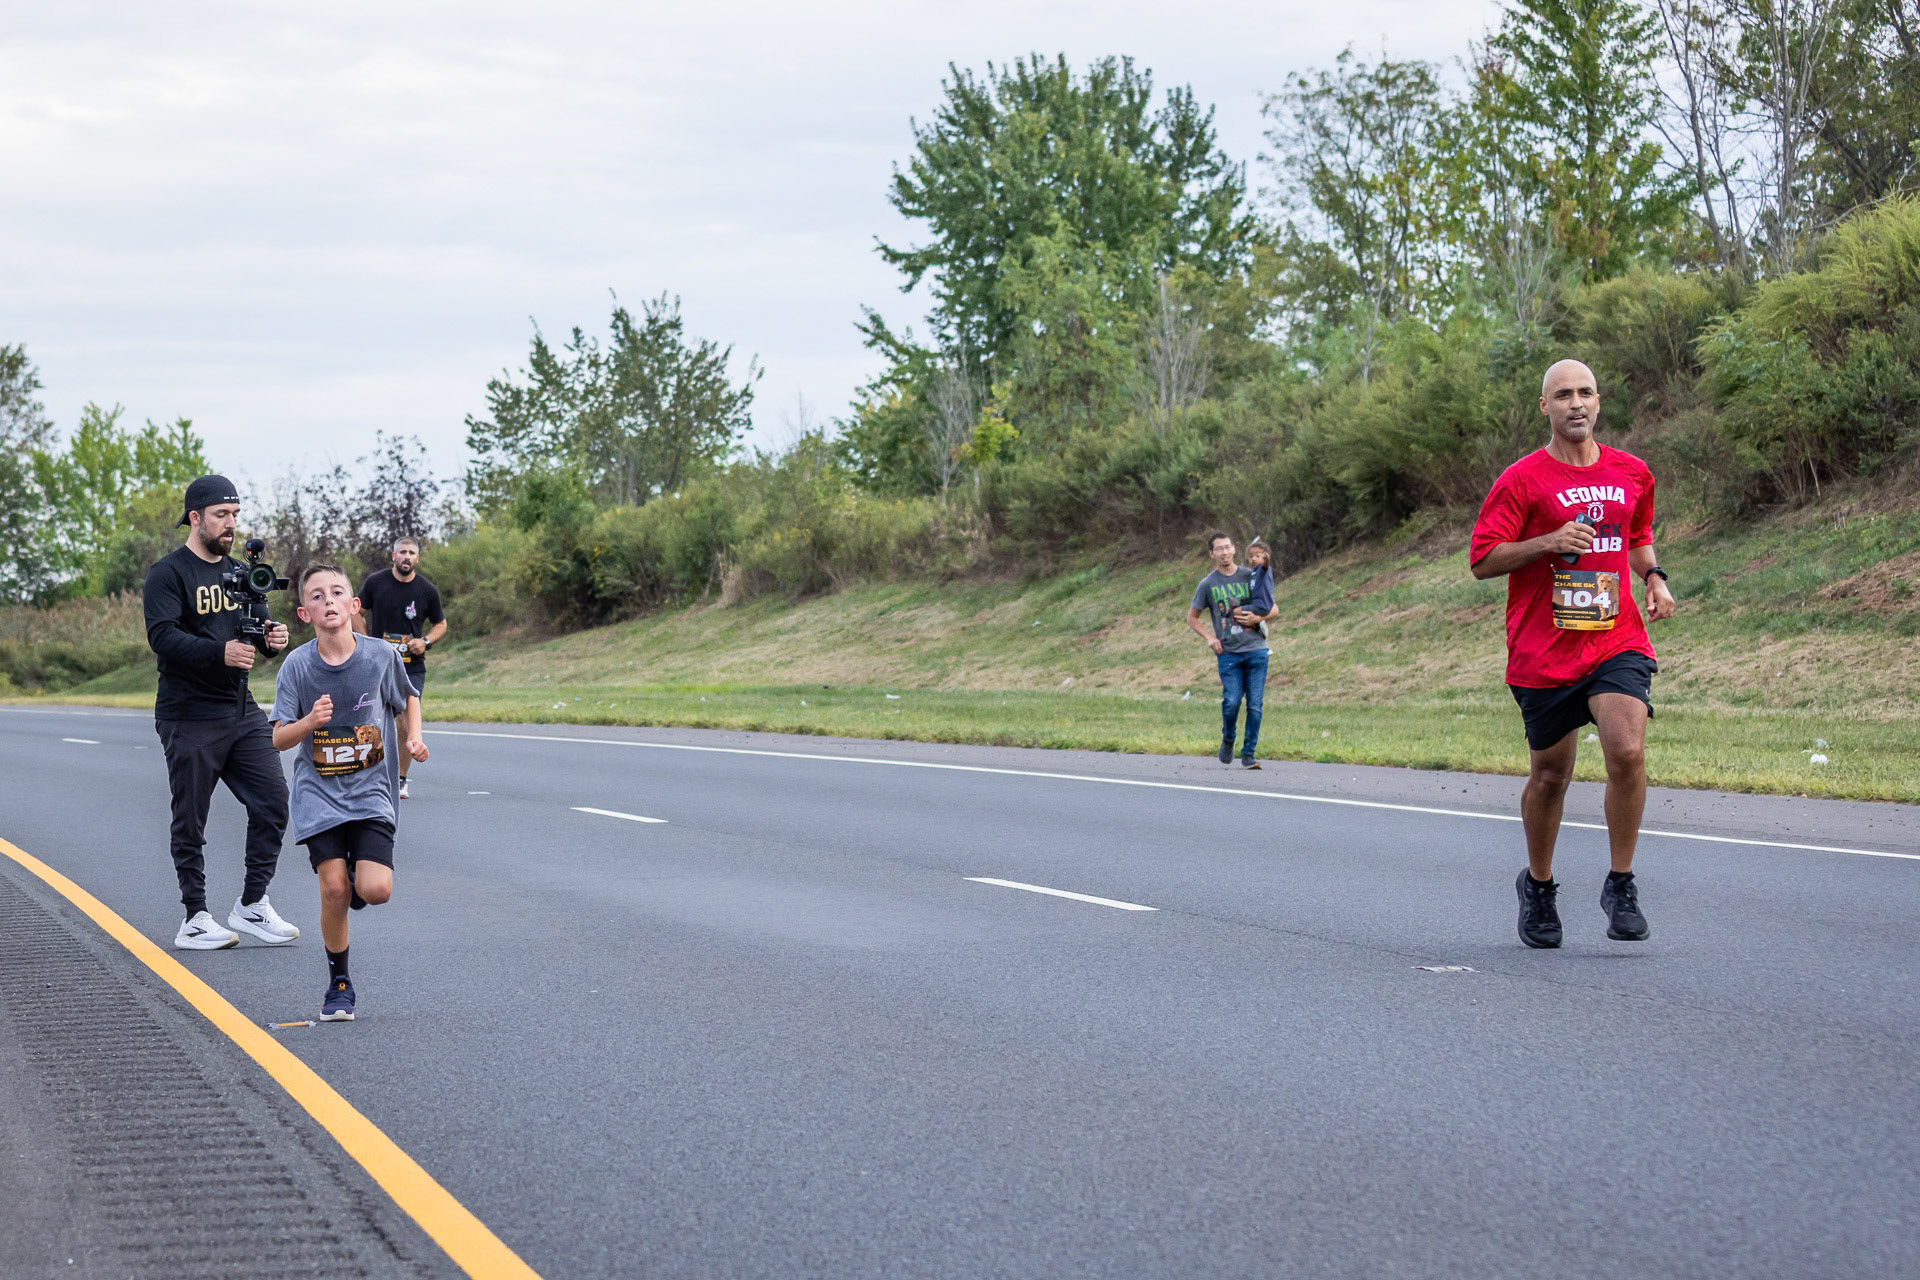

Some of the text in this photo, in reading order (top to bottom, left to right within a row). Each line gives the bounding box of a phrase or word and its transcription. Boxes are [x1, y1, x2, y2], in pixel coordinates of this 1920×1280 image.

[1556, 485, 1626, 508] LEONIA
[1561, 590, 1611, 609] 104
[322, 743, 373, 764] 127
